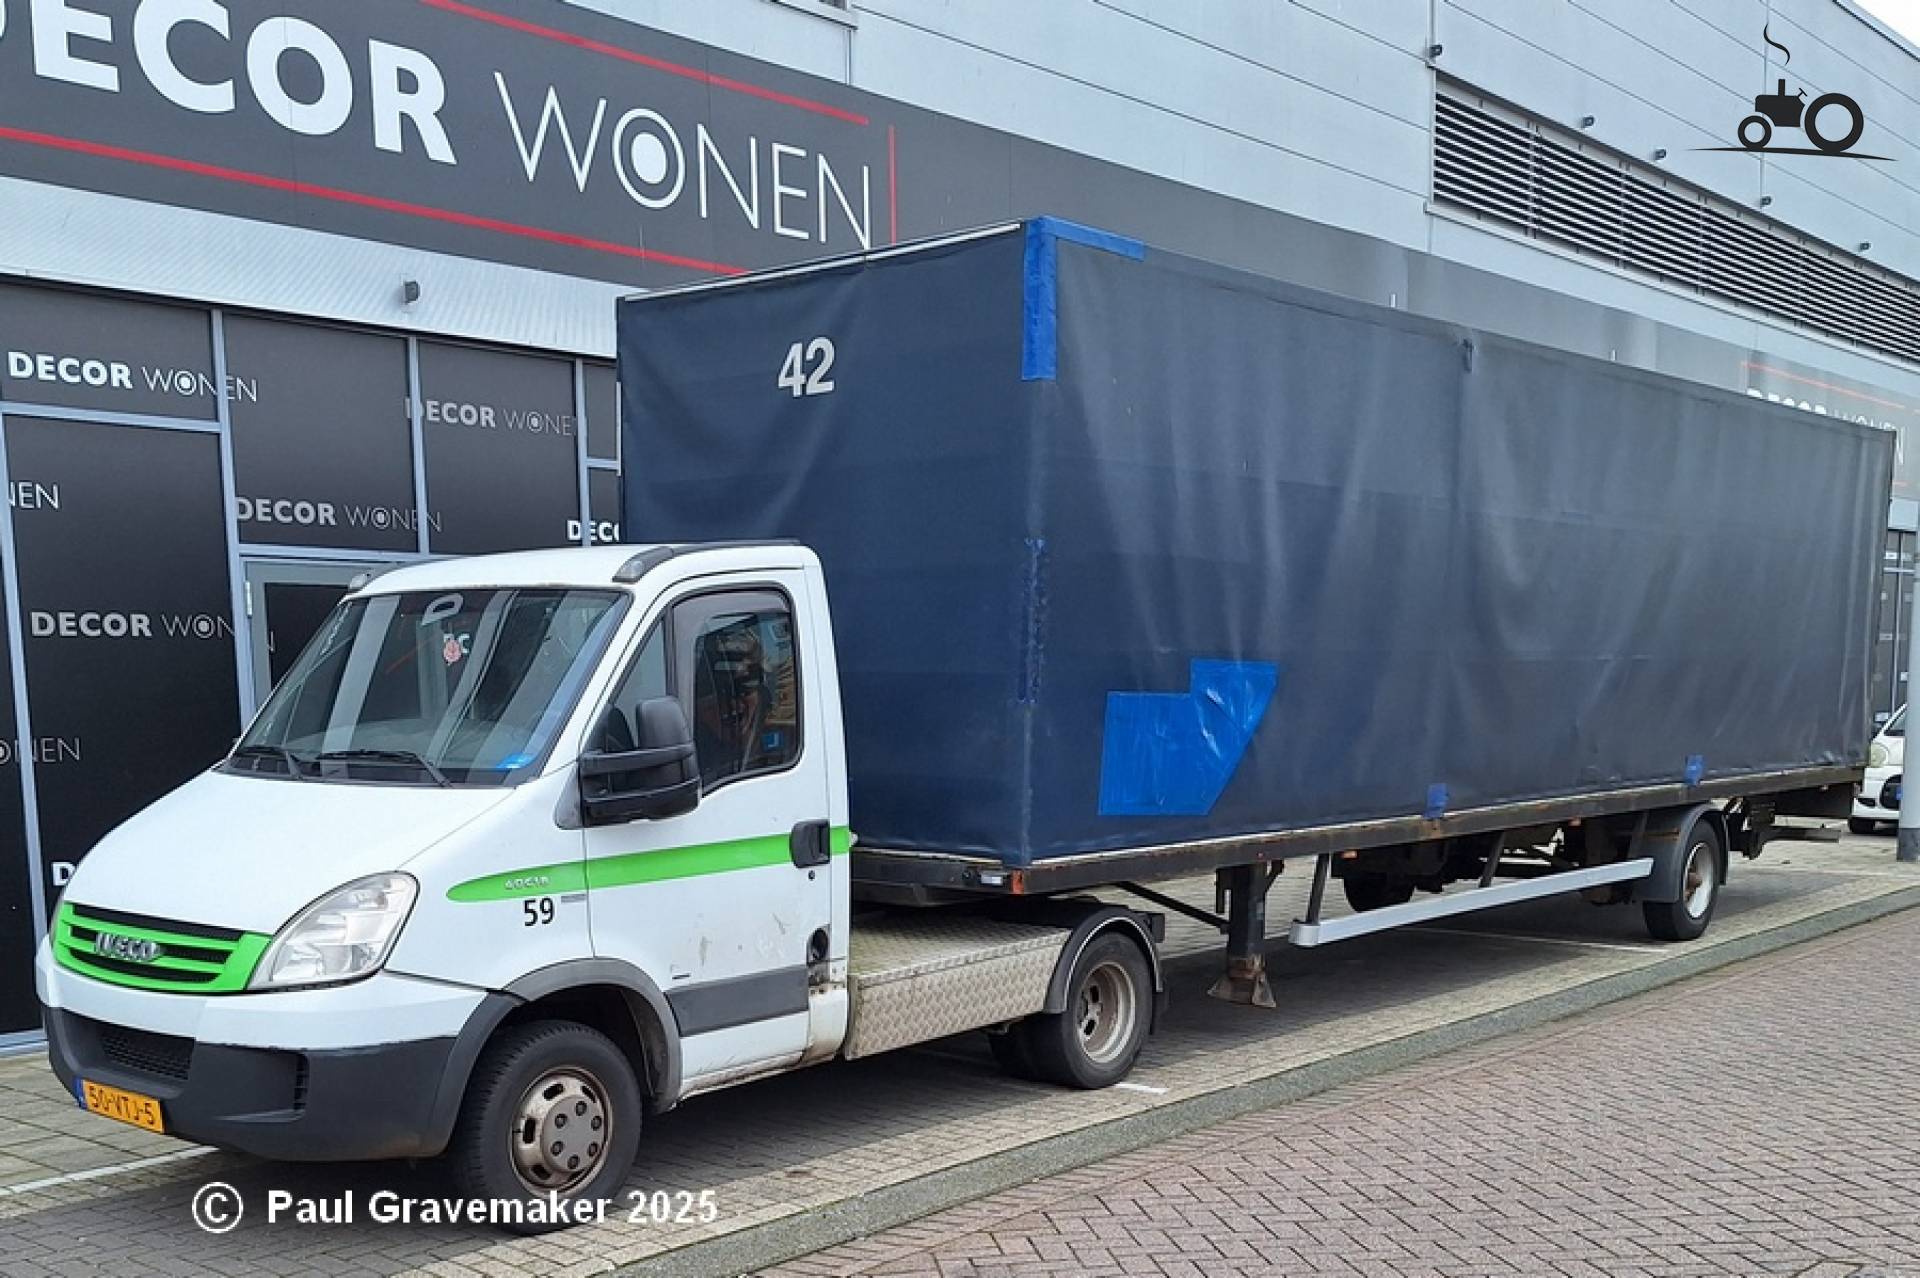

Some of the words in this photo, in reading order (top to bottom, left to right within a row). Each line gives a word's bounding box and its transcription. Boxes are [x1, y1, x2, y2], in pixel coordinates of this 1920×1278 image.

[0, 0, 457, 164] ECOR
[494, 72, 871, 250] WONEN
[8, 351, 133, 389] DECOR
[778, 336, 835, 398] 42
[503, 409, 578, 436] WONE
[31, 612, 152, 637] DECOR
[524, 897, 554, 927] 59
[96, 932, 160, 961] IVECO
